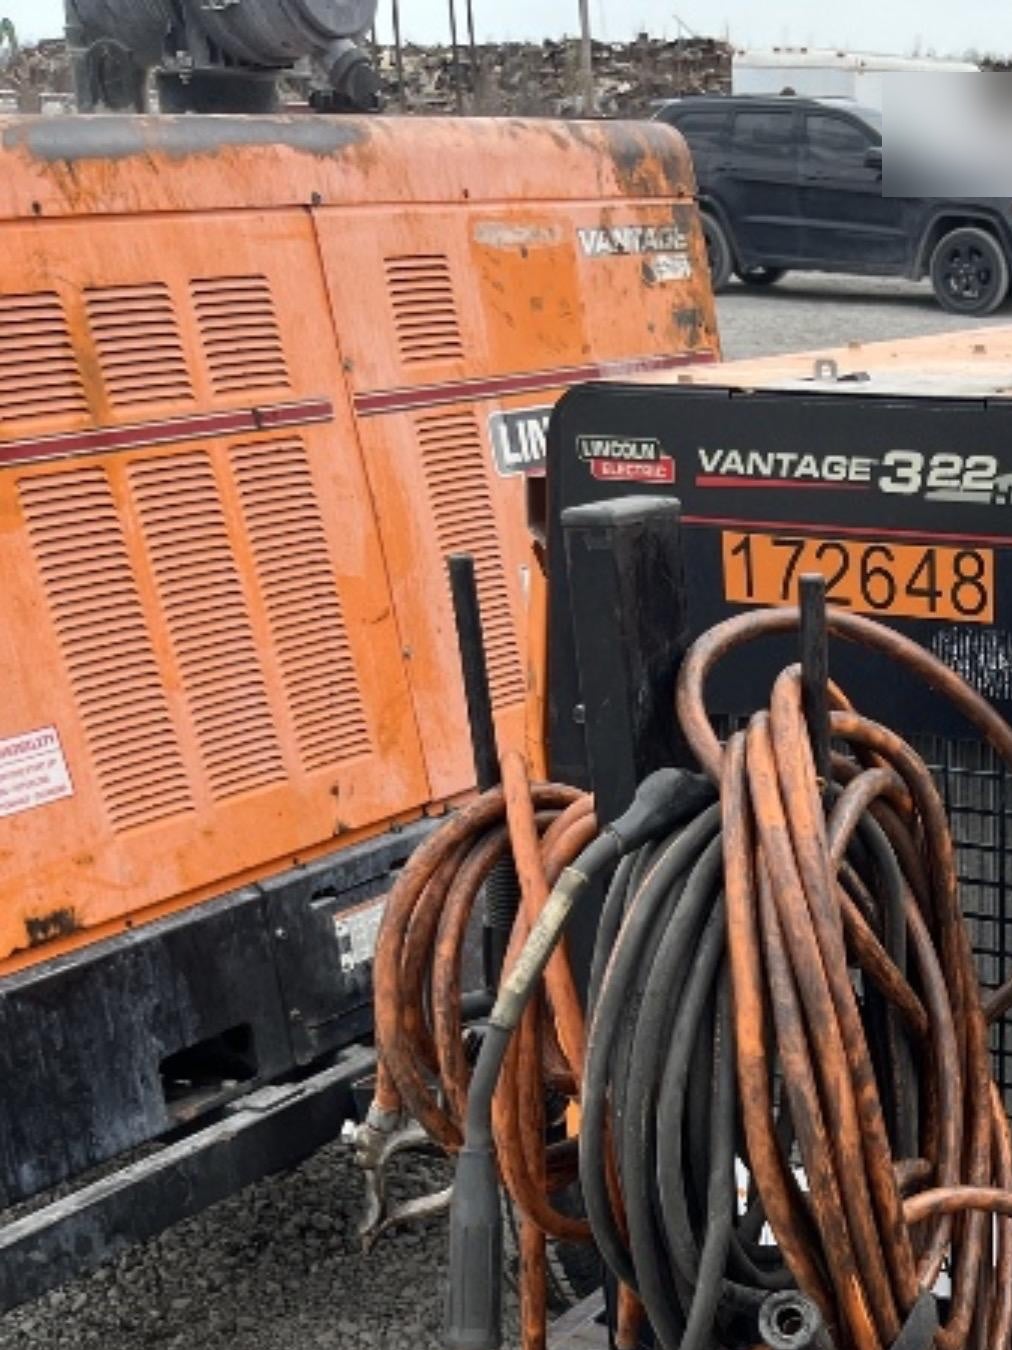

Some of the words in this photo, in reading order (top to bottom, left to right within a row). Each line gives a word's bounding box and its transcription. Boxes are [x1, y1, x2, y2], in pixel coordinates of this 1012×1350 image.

[577, 225, 688, 256] VANTAGE
[581, 440, 656, 460] LINCOLN
[698, 448, 872, 482] VANTAGE
[878, 450, 998, 494] 322
[731, 535, 988, 616] 172648
